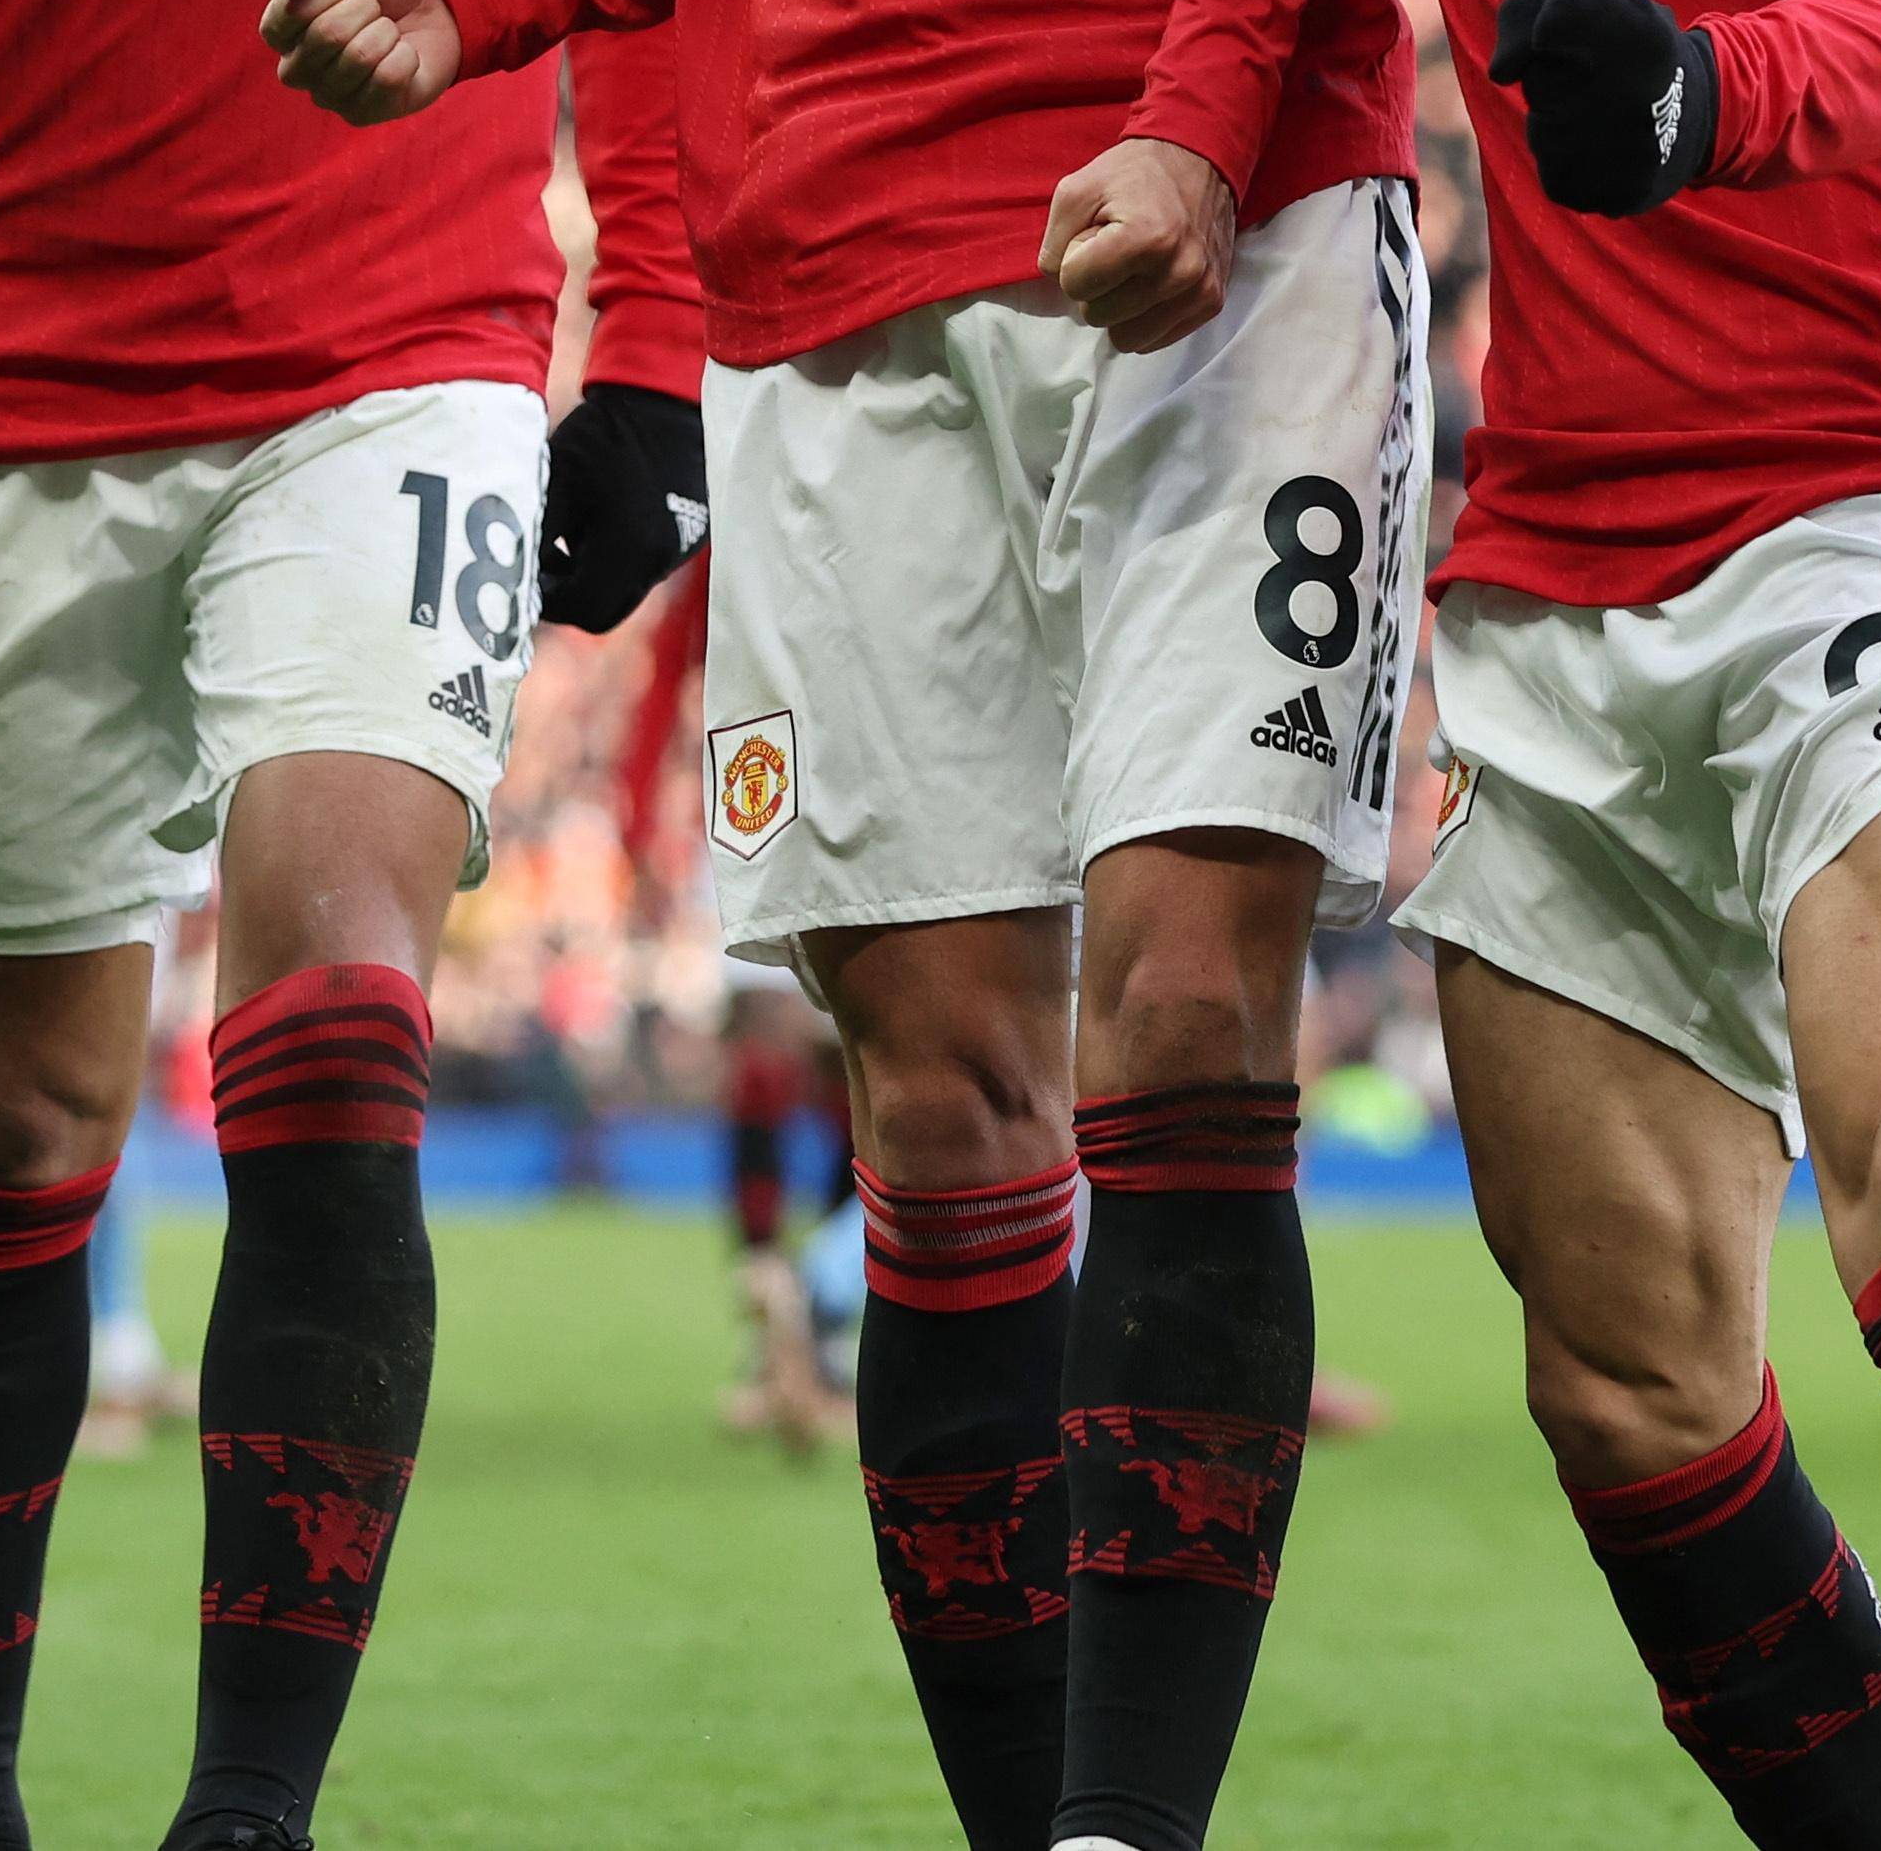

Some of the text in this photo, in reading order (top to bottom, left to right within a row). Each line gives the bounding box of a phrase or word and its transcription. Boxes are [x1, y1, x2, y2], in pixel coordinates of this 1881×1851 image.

[400, 469, 525, 661] 18
[1254, 475, 1364, 669] 8
[729, 741, 782, 781] MANCHESTER
[1250, 723, 1338, 768] adidas
[735, 808, 774, 829] UNITED
